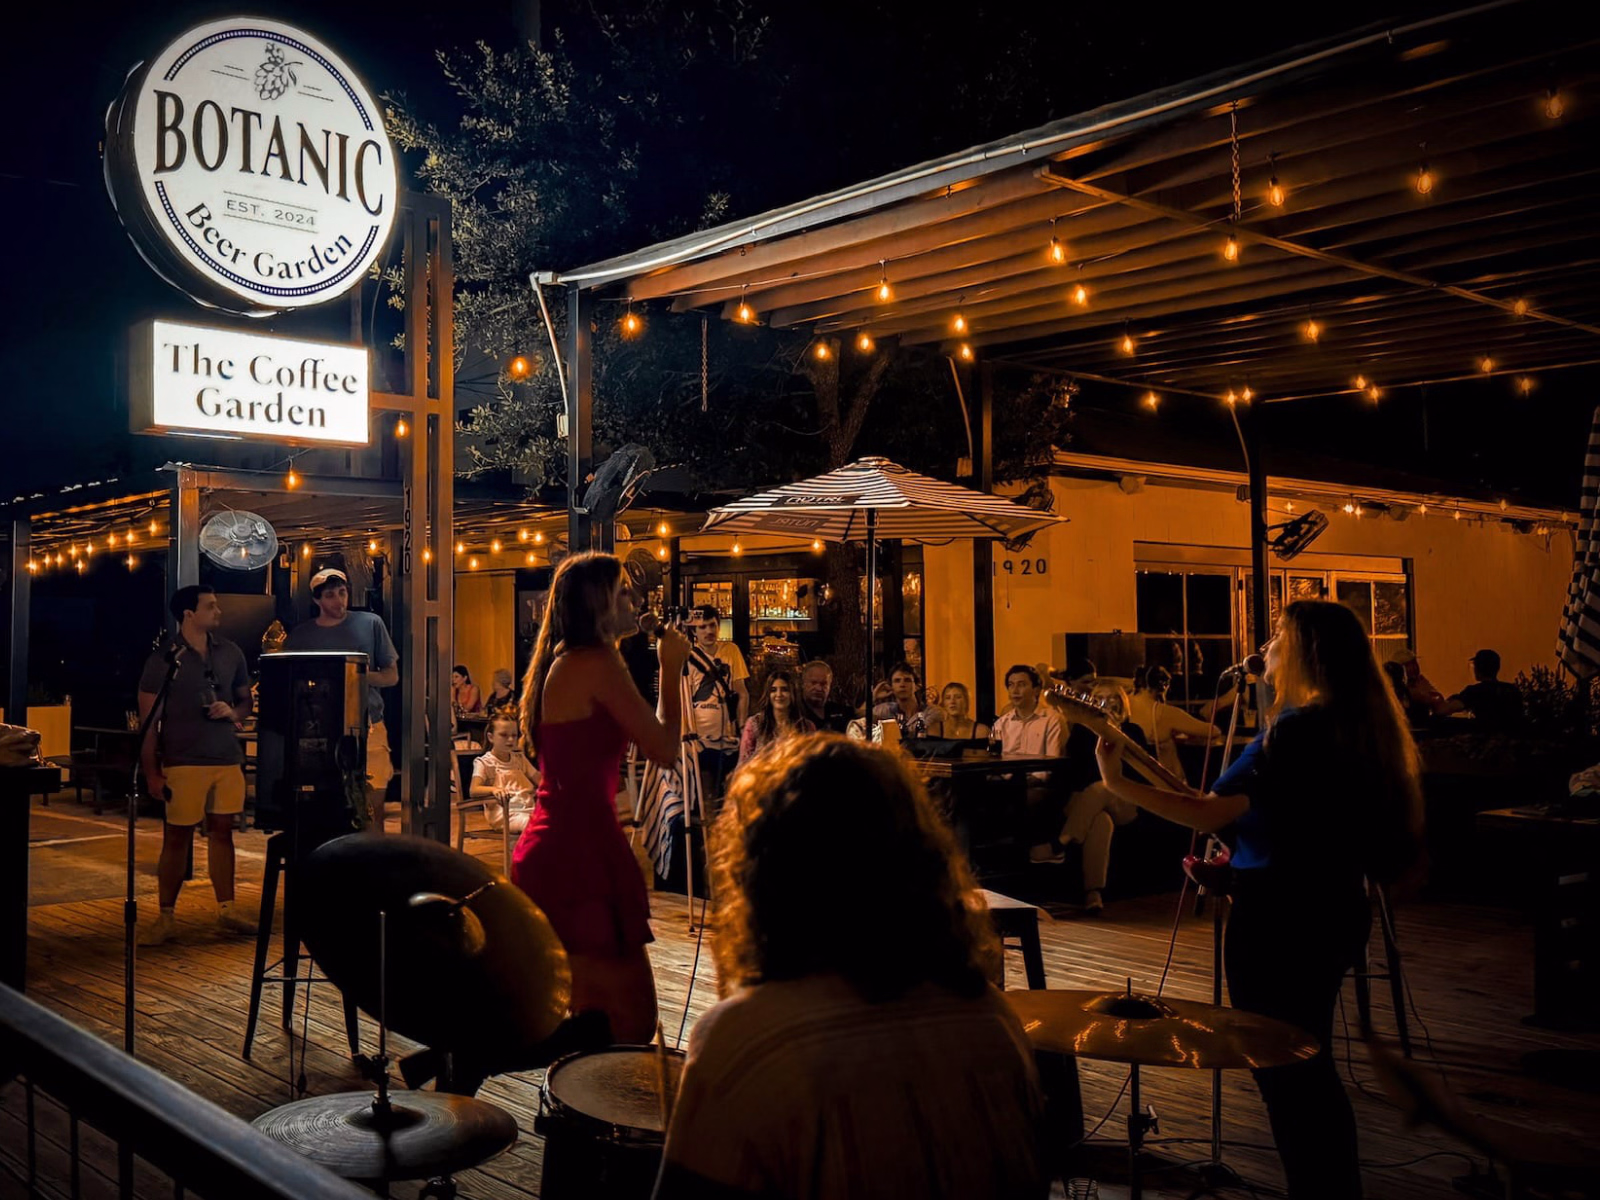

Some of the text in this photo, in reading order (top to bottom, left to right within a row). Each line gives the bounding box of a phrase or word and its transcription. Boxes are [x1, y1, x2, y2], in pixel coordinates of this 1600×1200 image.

[153, 89, 382, 216] BOTANIC
[226, 199, 316, 226] EST. 2024
[185, 203, 352, 280] Beer Garden
[163, 343, 358, 395] The Coffee
[196, 387, 326, 428] Garden
